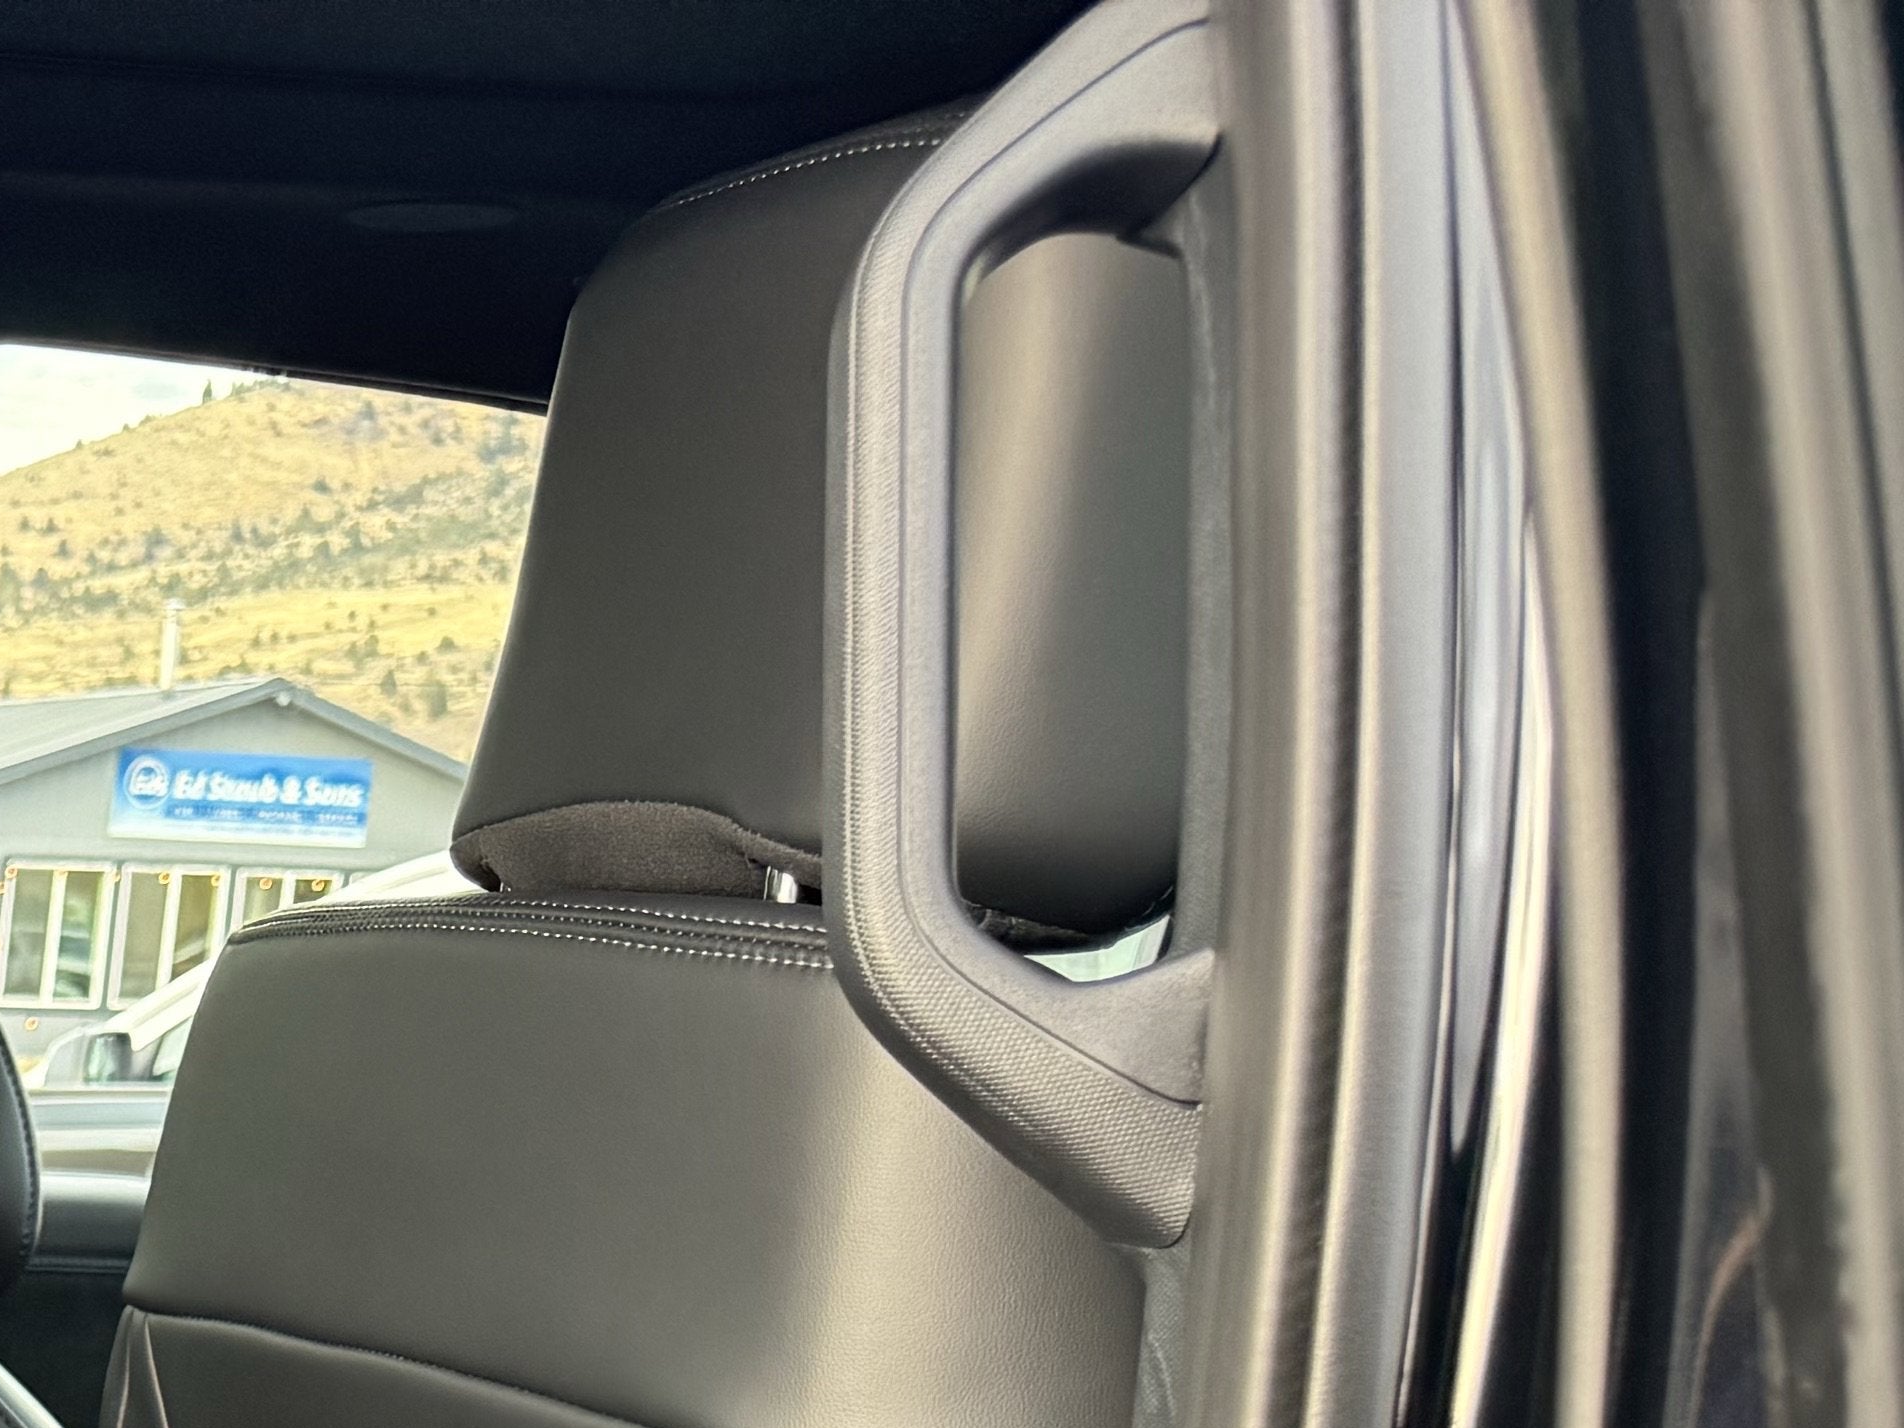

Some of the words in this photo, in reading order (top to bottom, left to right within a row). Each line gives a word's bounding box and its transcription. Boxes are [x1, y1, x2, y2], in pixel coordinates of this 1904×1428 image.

[172, 769, 207, 799] Ed
[280, 774, 302, 805] &
[303, 776, 365, 807] Sons
